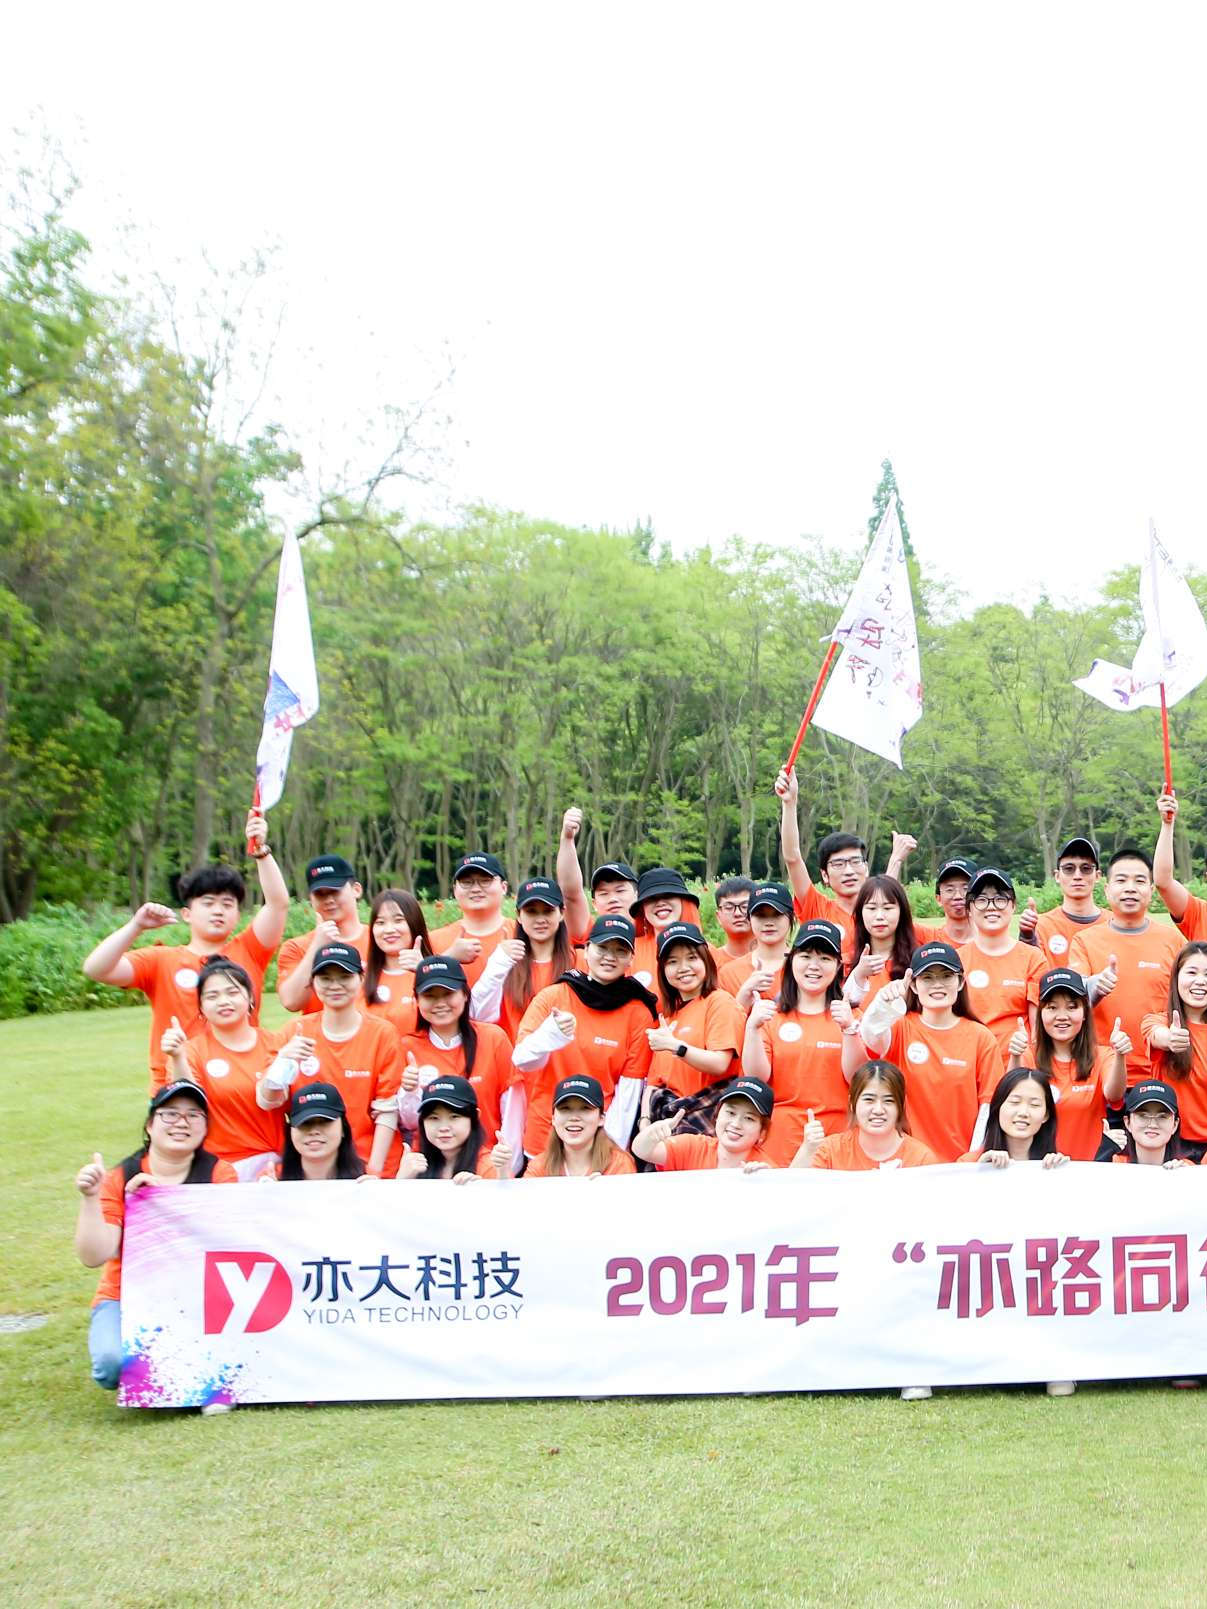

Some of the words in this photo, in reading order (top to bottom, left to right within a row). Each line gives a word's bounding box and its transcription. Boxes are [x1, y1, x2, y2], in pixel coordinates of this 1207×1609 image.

[302, 1251, 523, 1303] 亦大科技
[605, 1244, 839, 1326] 2021年
[303, 1308, 356, 1325] YIDA
[365, 1304, 524, 1323] TECHNOLOGY
